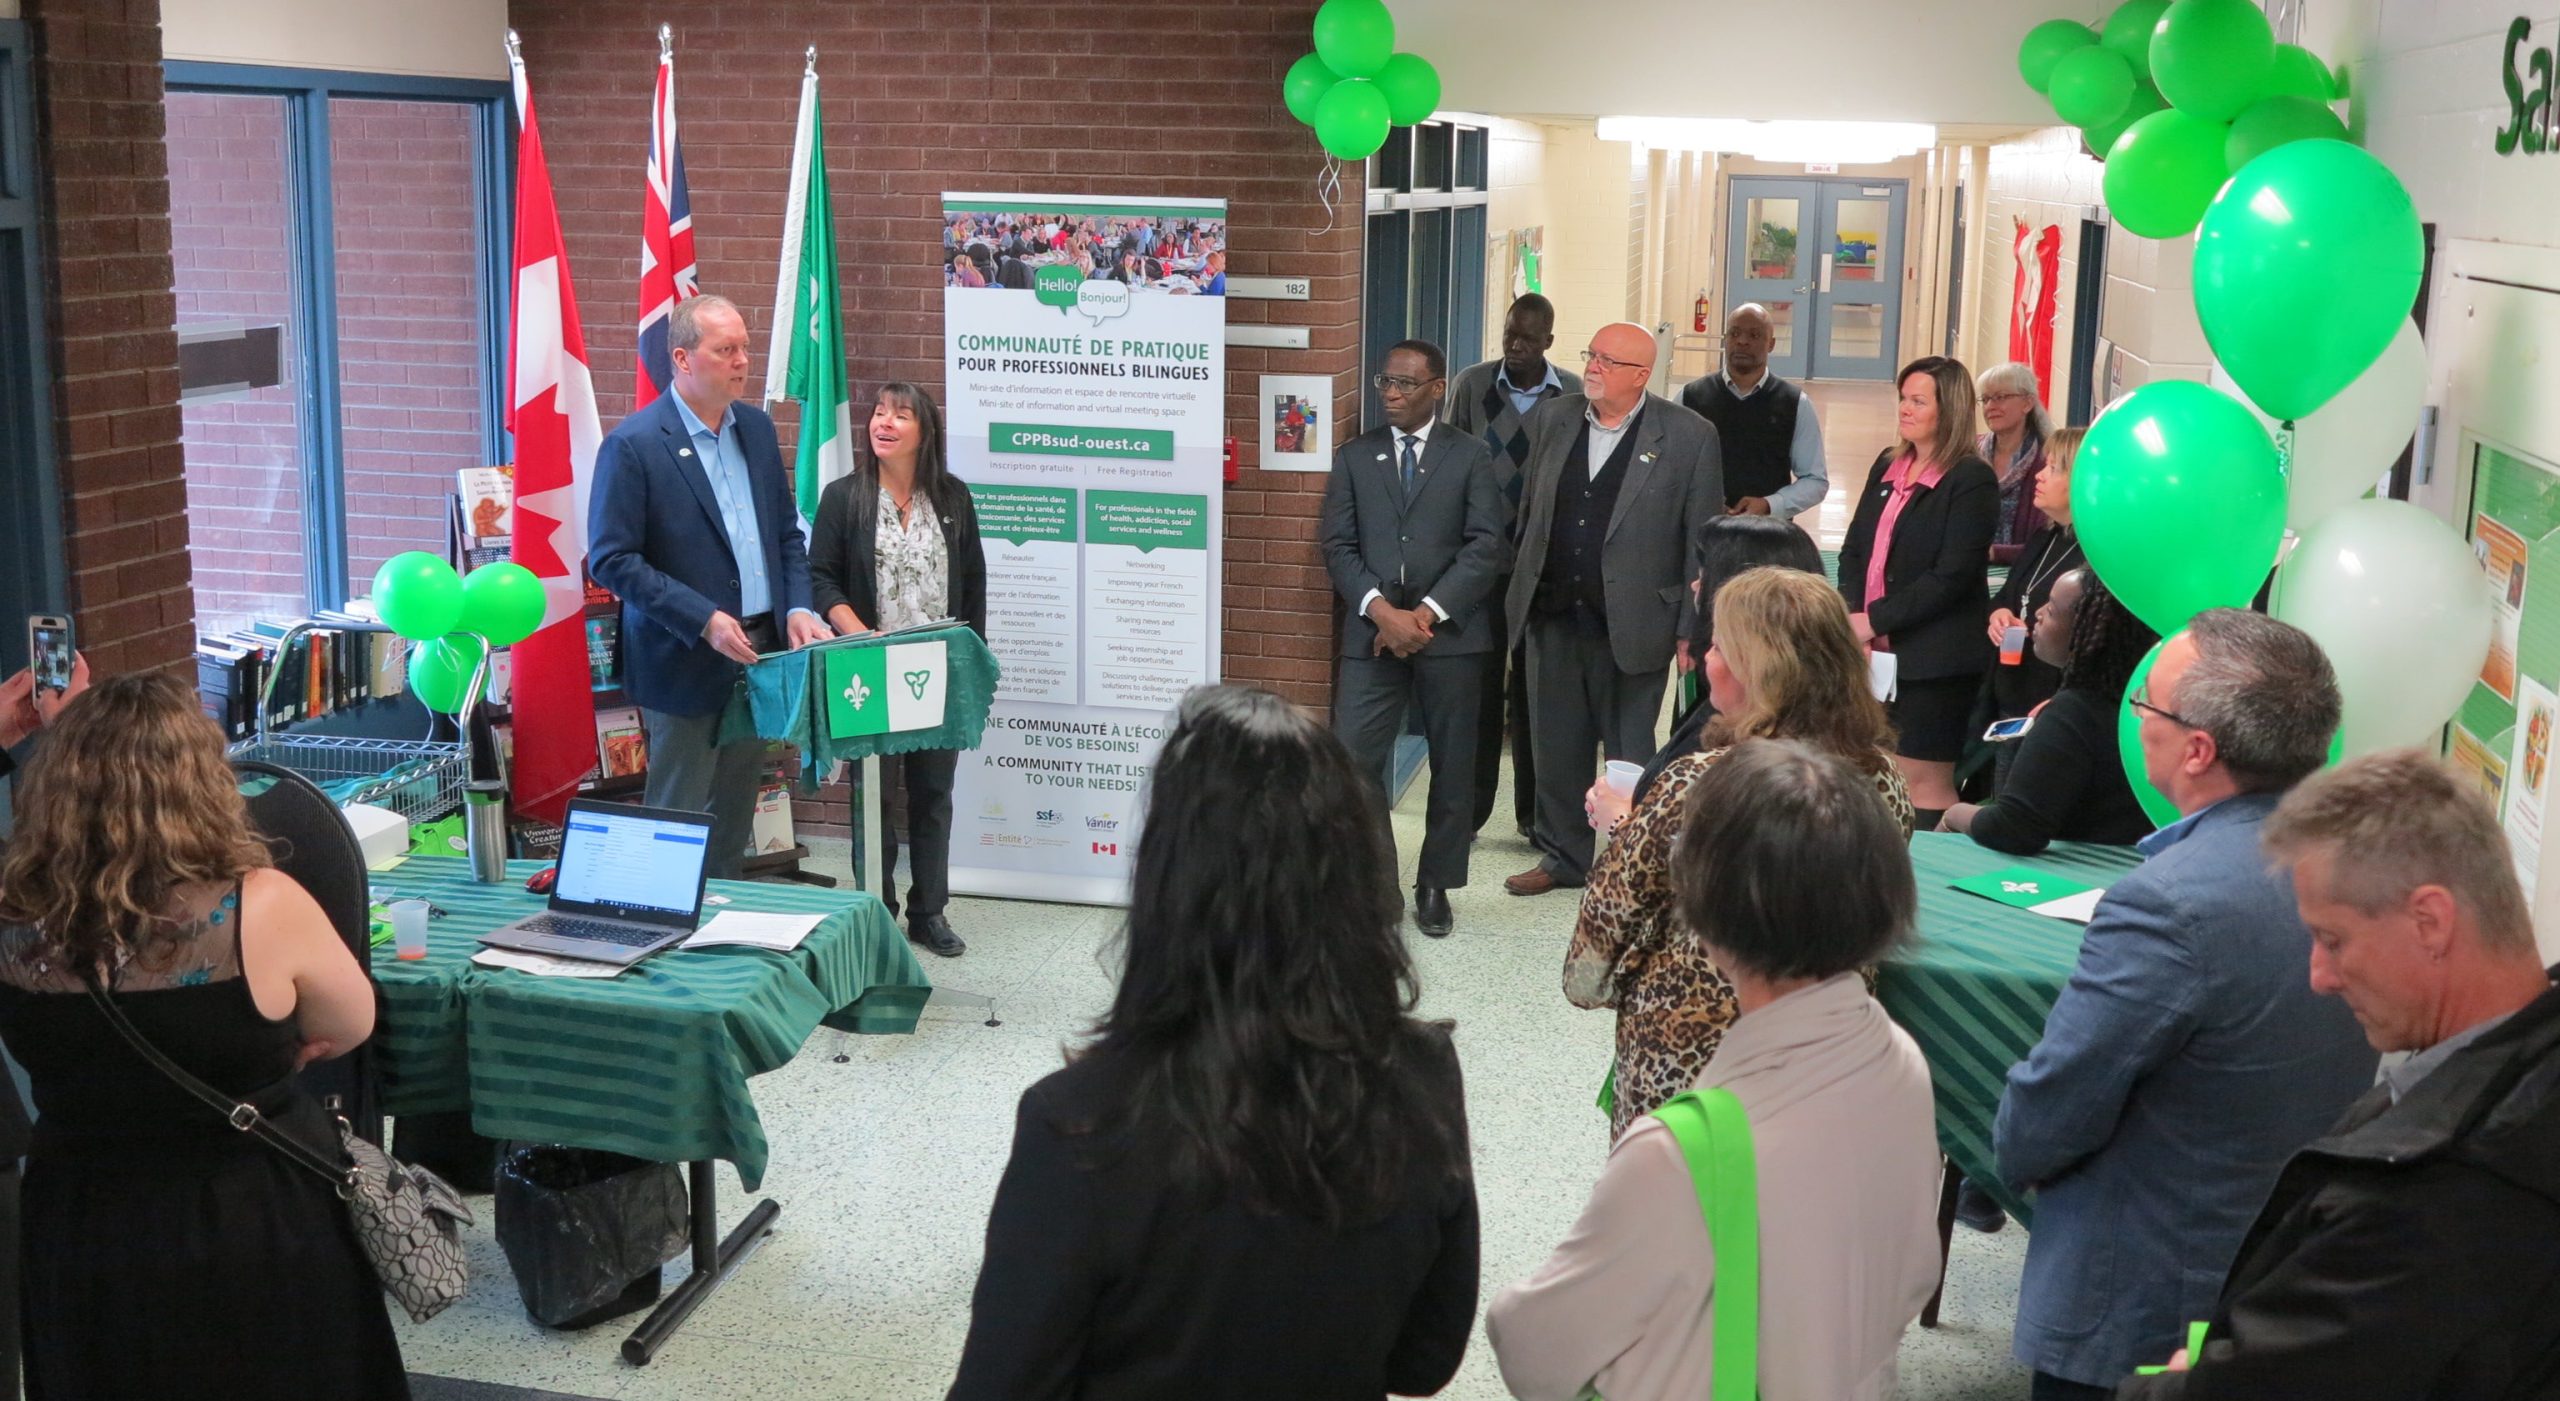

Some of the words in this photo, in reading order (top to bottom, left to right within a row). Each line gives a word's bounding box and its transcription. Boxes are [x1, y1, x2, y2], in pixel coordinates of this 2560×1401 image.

[1038, 278, 1078, 292] Hello!
[1285, 284, 1306, 294] 182
[1080, 292, 1126, 304] Bonjour!
[958, 334, 1082, 355] COMMUNAUTÉ
[1091, 339, 1113, 356] DE
[1122, 340, 1210, 362] PRATIQUE
[958, 357, 996, 372] POUR
[1002, 358, 1126, 377] PROFESSIONNELS
[1132, 364, 1209, 380] BILINGUES
[969, 383, 1004, 393] Mini-site
[1006, 384, 1062, 396] d'information
[1064, 386, 1074, 396] et
[1075, 388, 1104, 399] espace
[1106, 388, 1118, 398] de
[1119, 390, 1160, 400] rencontre
[1161, 390, 1196, 401] virtuelle
[978, 399, 1014, 409] Mini-site
[1016, 400, 1025, 409] of
[1027, 400, 1074, 412] information
[1077, 402, 1094, 412] and
[1096, 403, 1122, 414] virtual
[1124, 404, 1160, 416] meeting
[1161, 408, 1186, 418] space
[1011, 432, 1150, 452] CPPBsud-ouest.ca
[989, 460, 1038, 472] Inscription
[1039, 462, 1074, 474] gratuite
[1097, 466, 1117, 475] Free
[1118, 467, 1173, 479] Registration
[998, 493, 1048, 503] professionnels
[980, 503, 1015, 511] domaines
[1035, 505, 1055, 513] santé,
[1108, 504, 1155, 514] professionals
[1177, 508, 1197, 516] fields
[1110, 514, 1134, 523] health,
[1135, 517, 1169, 525] addiction,
[1153, 528, 1183, 536] wellness
[1126, 561, 1165, 571] Networking
[1108, 578, 1142, 588] Improving
[1161, 581, 1183, 589] French
[1106, 596, 1145, 607] Exchanging
[1146, 600, 1185, 608] information
[1116, 616, 1141, 625] Sharing
[1107, 644, 1134, 653] Seeking
[1135, 646, 1168, 655] internship
[1129, 656, 1174, 665] opportunities
[1102, 672, 1137, 681] Discussing
[1138, 675, 1173, 684] challenges
[1152, 695, 1174, 703] French
[986, 718, 1004, 728] NE
[1008, 718, 1107, 736] COMMUNAUTÉ
[1111, 725, 1120, 736] À
[1024, 735, 1042, 746] DE
[1046, 736, 1072, 748] VOS
[1077, 738, 1139, 753] BESOINS!
[984, 756, 993, 766] A
[997, 756, 1082, 773] COMMUNITY
[1086, 762, 1122, 775] THAT
[1025, 773, 1043, 785] TO
[1047, 774, 1084, 788] YOUR
[1088, 778, 1137, 792] NEEDS!
[1085, 816, 1119, 828] Vanier
